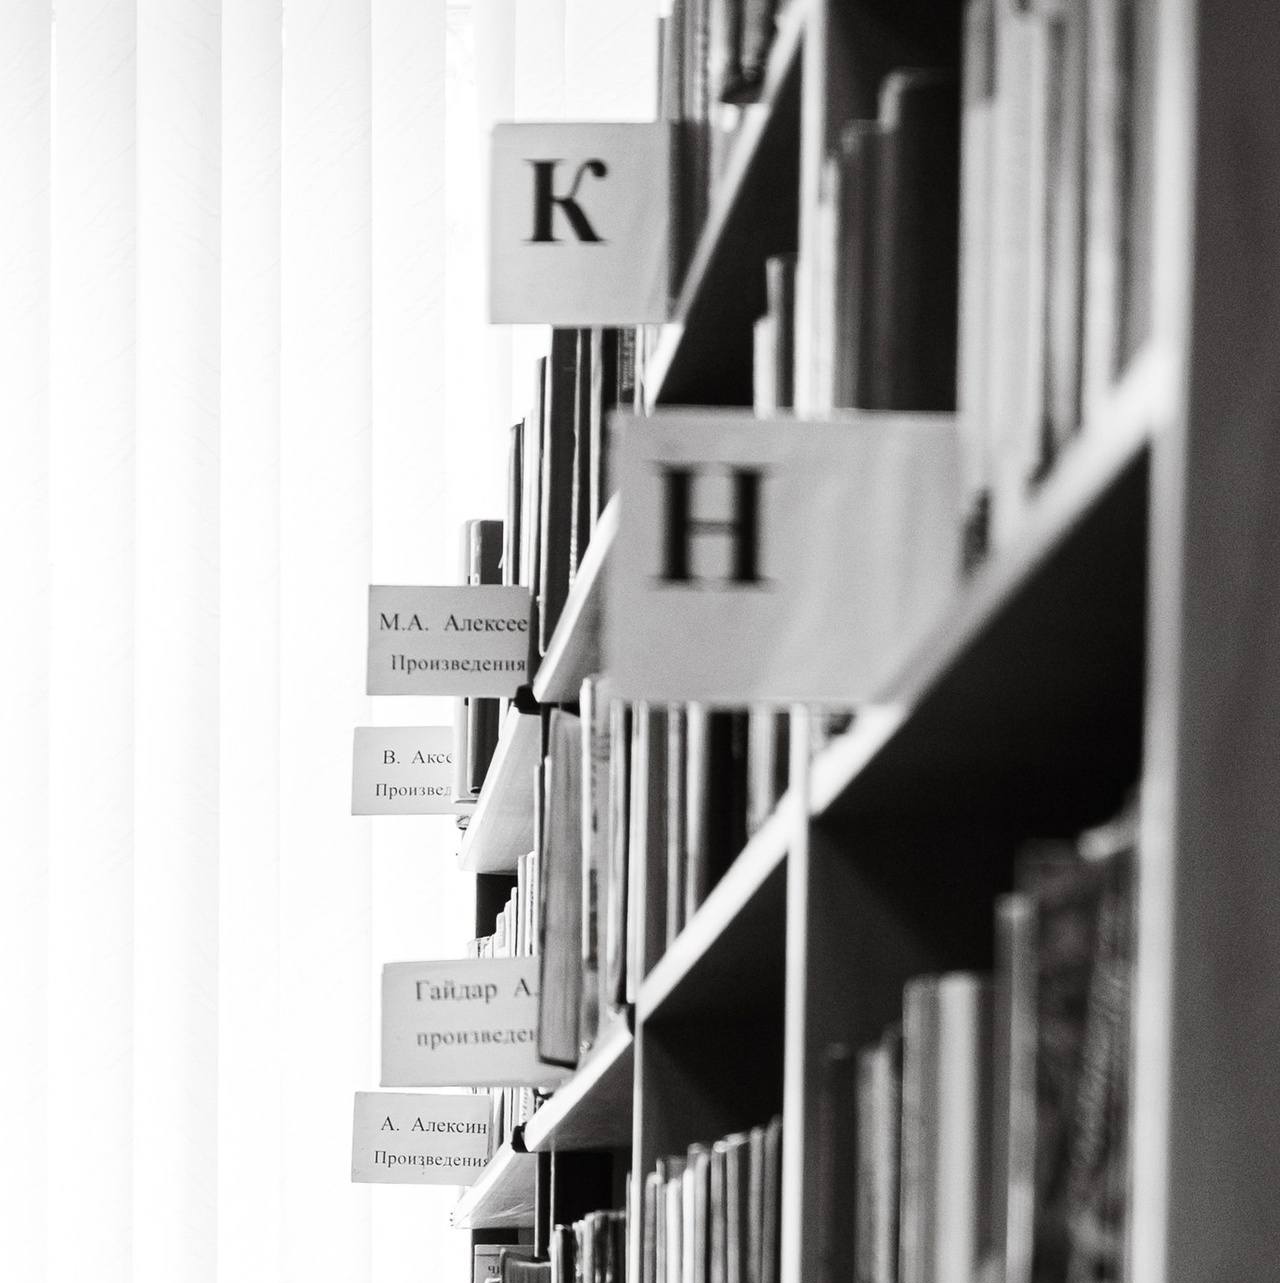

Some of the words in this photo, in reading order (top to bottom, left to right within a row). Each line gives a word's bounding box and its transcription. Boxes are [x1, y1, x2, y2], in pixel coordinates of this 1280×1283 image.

[522, 157, 608, 244] К
[654, 460, 776, 590] Н
[380, 612, 429, 632] М.А.
[444, 613, 528, 632] Алексее
[391, 653, 526, 675] Произведения
[383, 749, 401, 765] В.
[415, 979, 498, 1004] Гайдар
[380, 1115, 400, 1132] А.
[411, 1116, 487, 1135] Алексин
